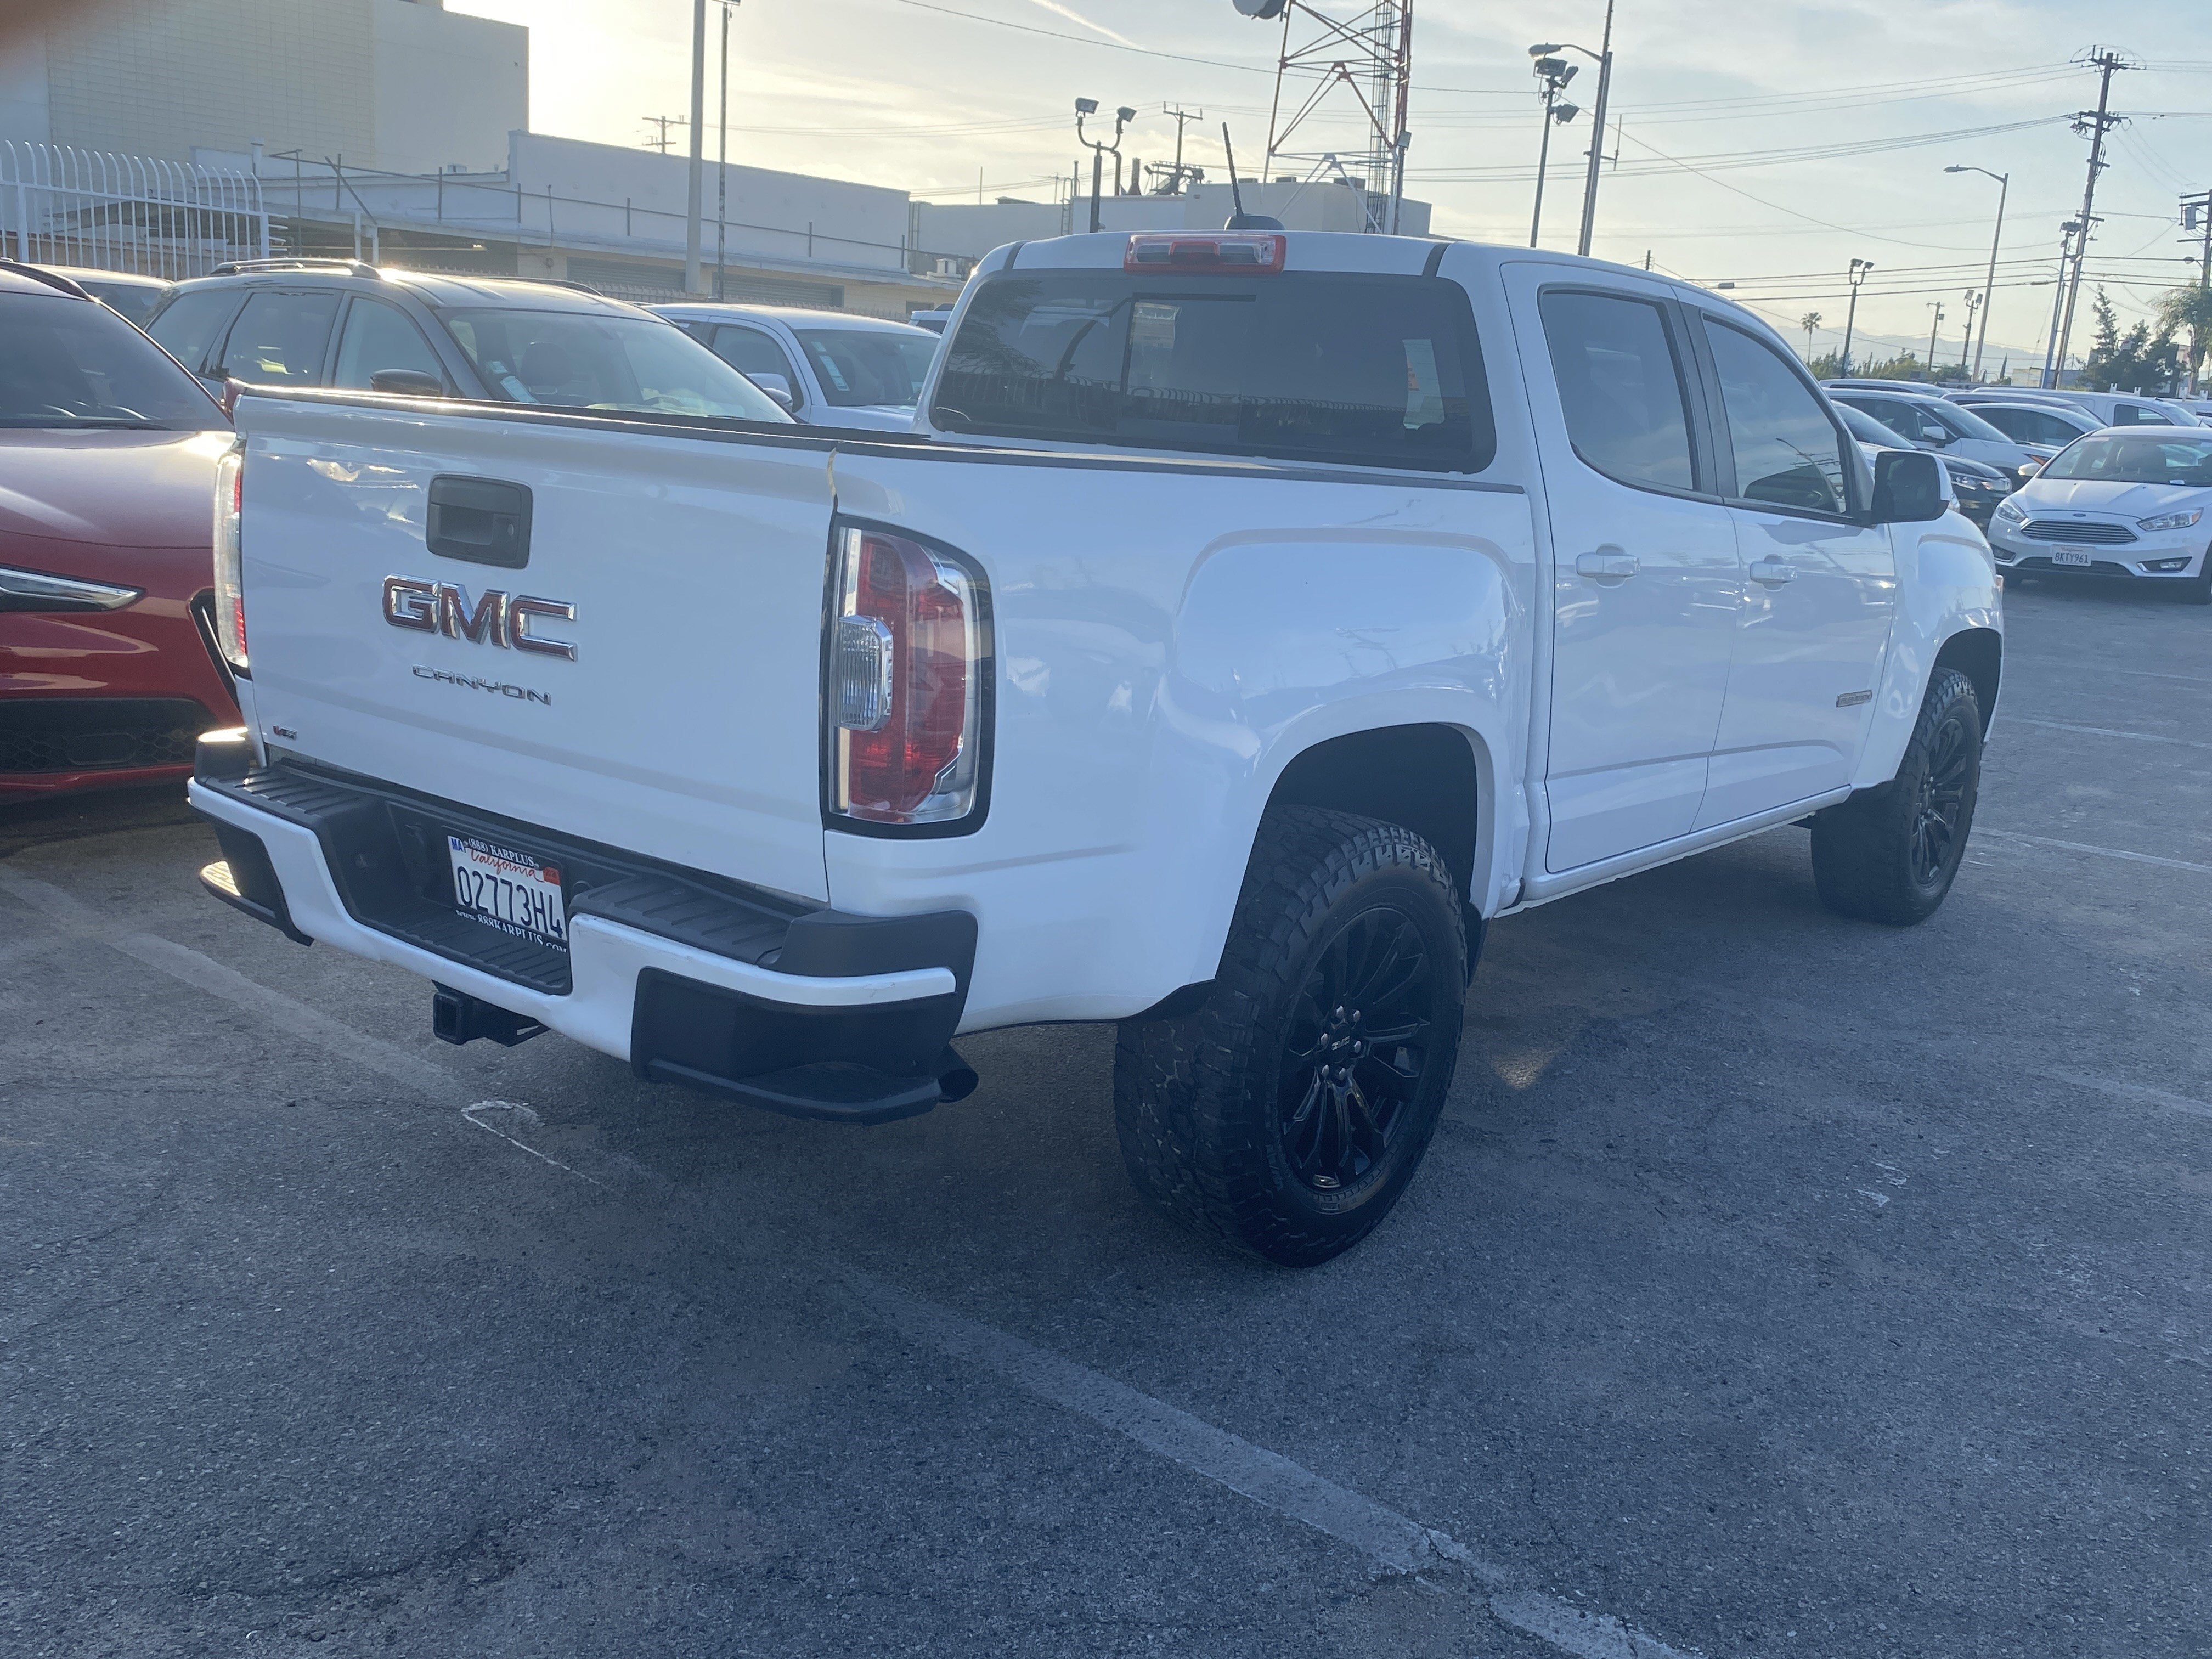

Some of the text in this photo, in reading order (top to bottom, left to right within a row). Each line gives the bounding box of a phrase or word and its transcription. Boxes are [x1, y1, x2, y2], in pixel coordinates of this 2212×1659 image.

[2055, 552, 2089, 563] 8KTY961
[382, 573, 578, 662] GMC
[412, 663, 551, 706] CANYON
[450, 837, 466, 853] MA
[468, 838, 535, 867] (888) KARPLUS
[457, 866, 563, 938] 02773H4
